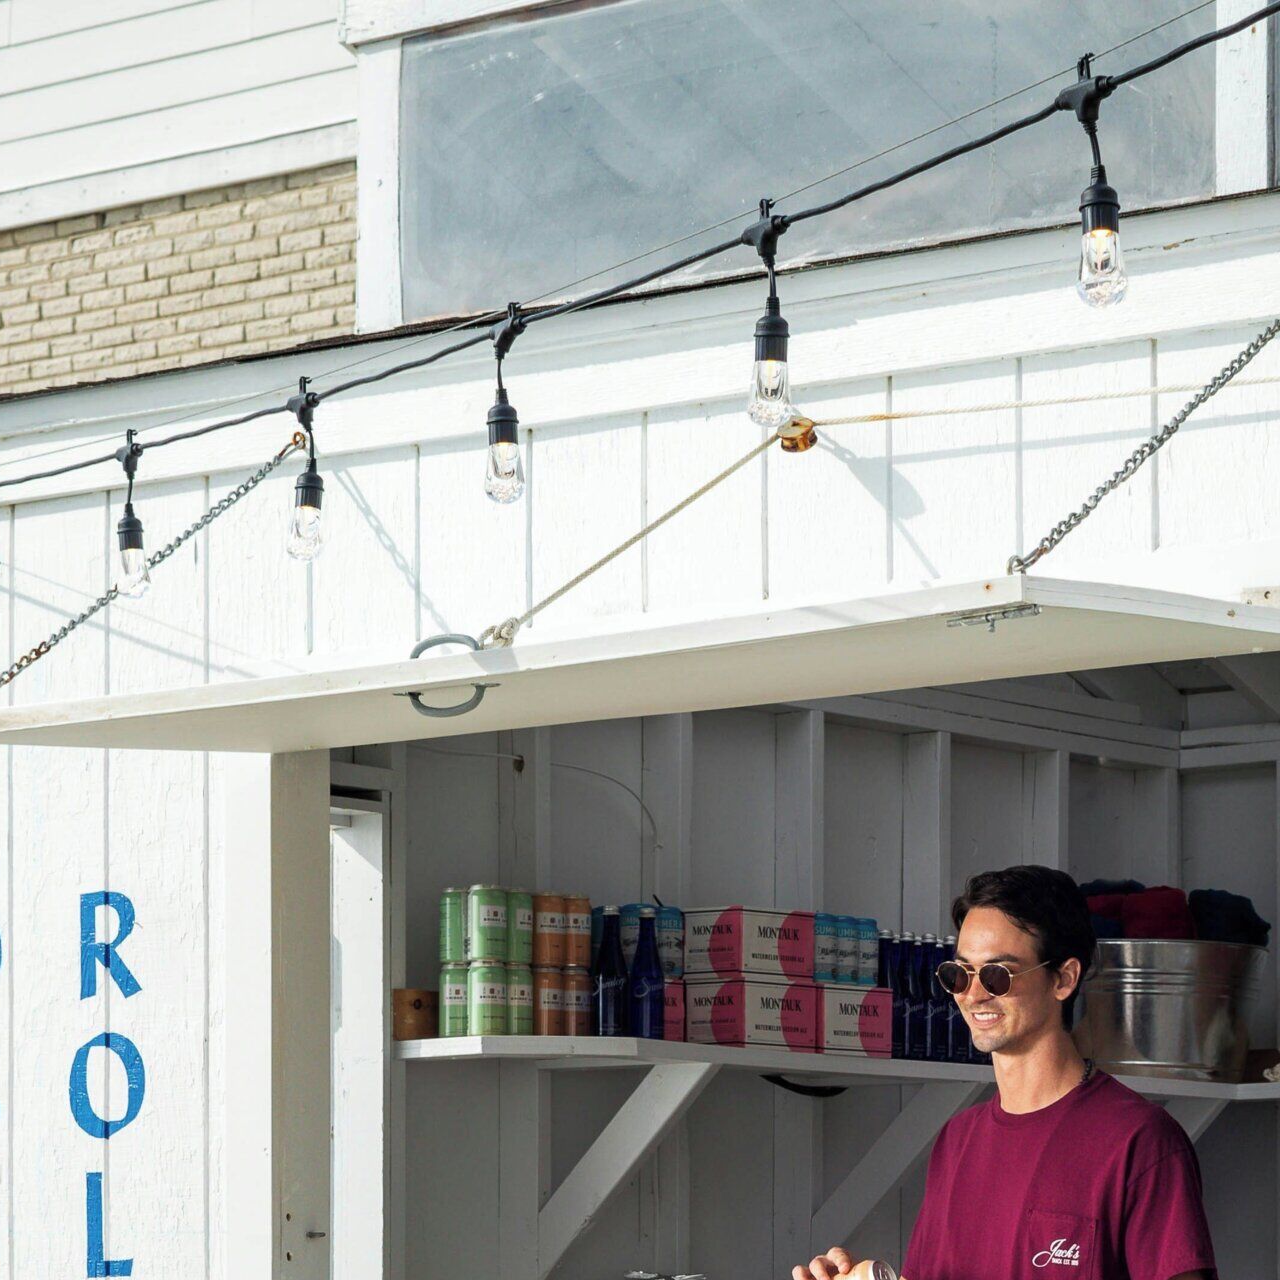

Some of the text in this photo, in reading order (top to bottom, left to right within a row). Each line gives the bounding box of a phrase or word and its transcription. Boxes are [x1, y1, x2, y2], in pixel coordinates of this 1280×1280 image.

[692, 924, 733, 936] MONTAUK
[757, 925, 800, 941] MONTAUK
[693, 996, 734, 1008] MONTAUK
[760, 997, 802, 1012] MONTAUK
[839, 1003, 879, 1017] MONTAUK
[1032, 1238, 1080, 1267] Jack's
